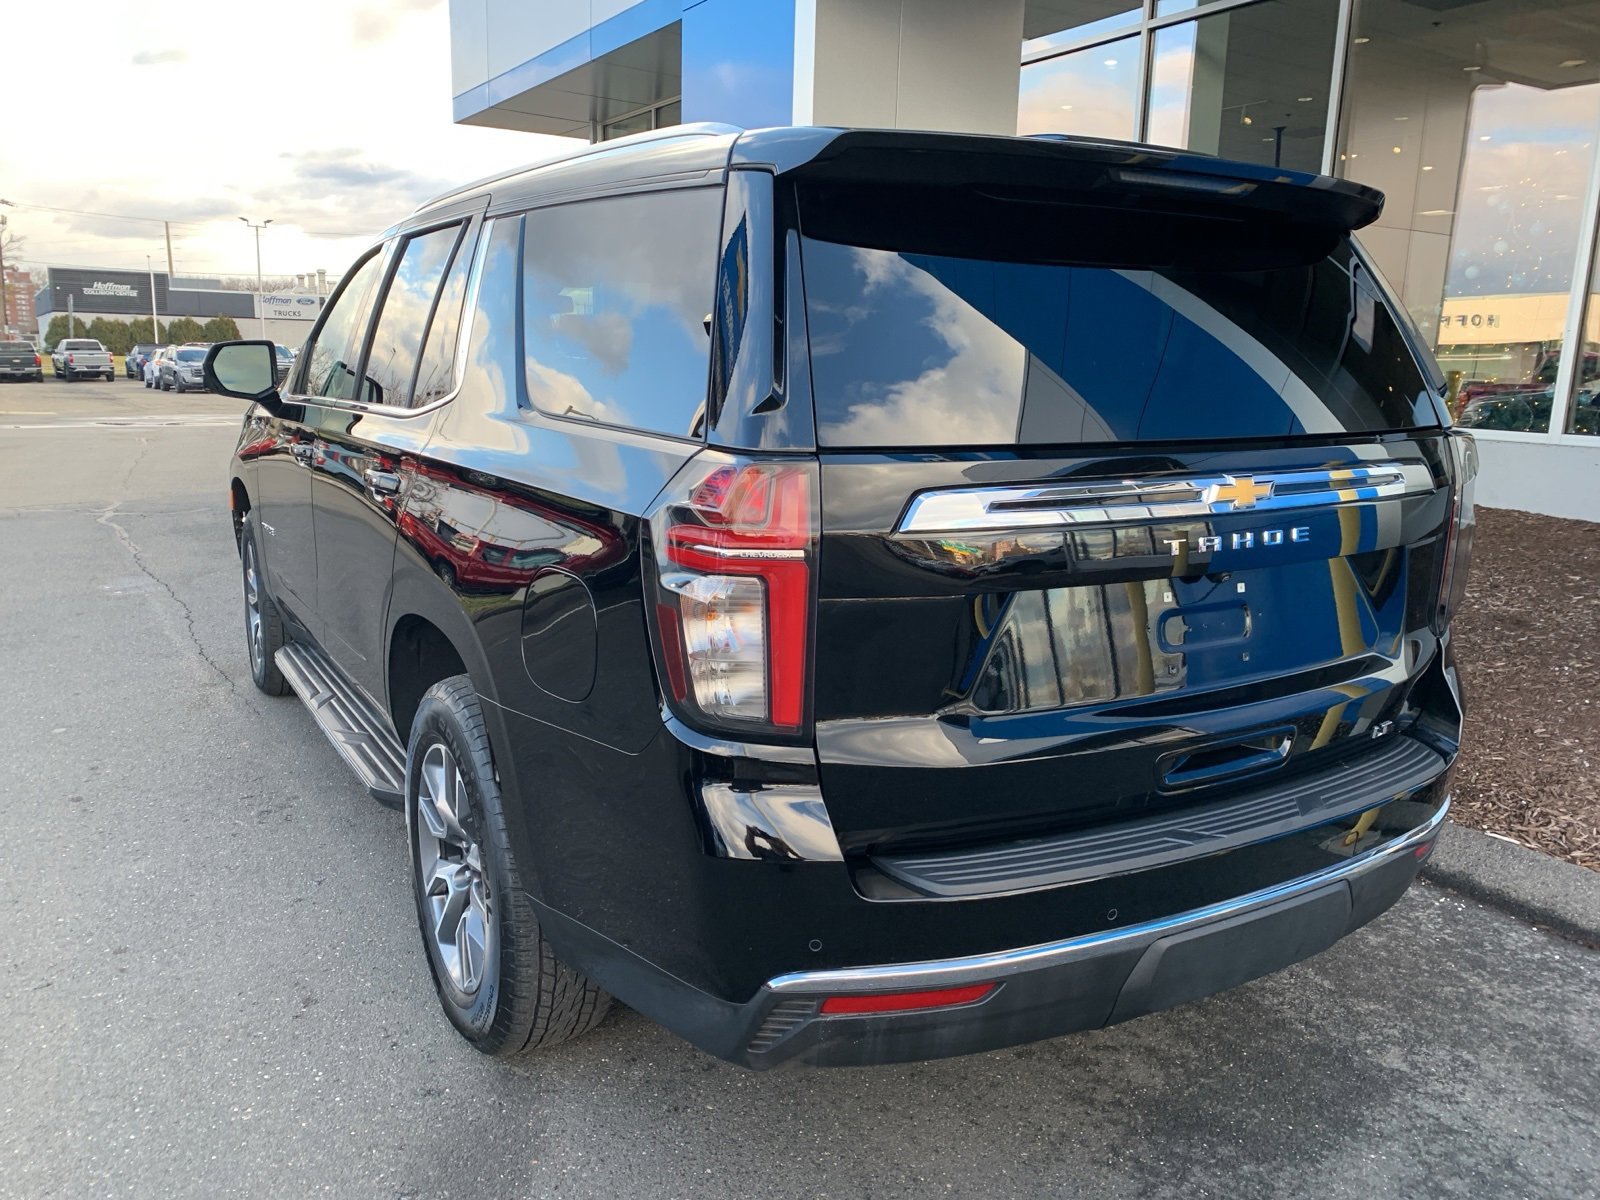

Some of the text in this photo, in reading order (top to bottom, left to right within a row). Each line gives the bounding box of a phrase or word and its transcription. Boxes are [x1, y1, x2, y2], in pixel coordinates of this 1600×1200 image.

[93, 281, 131, 291] Hoffman
[1163, 526, 1310, 556] TAHOE
[1371, 720, 1393, 739] LT
